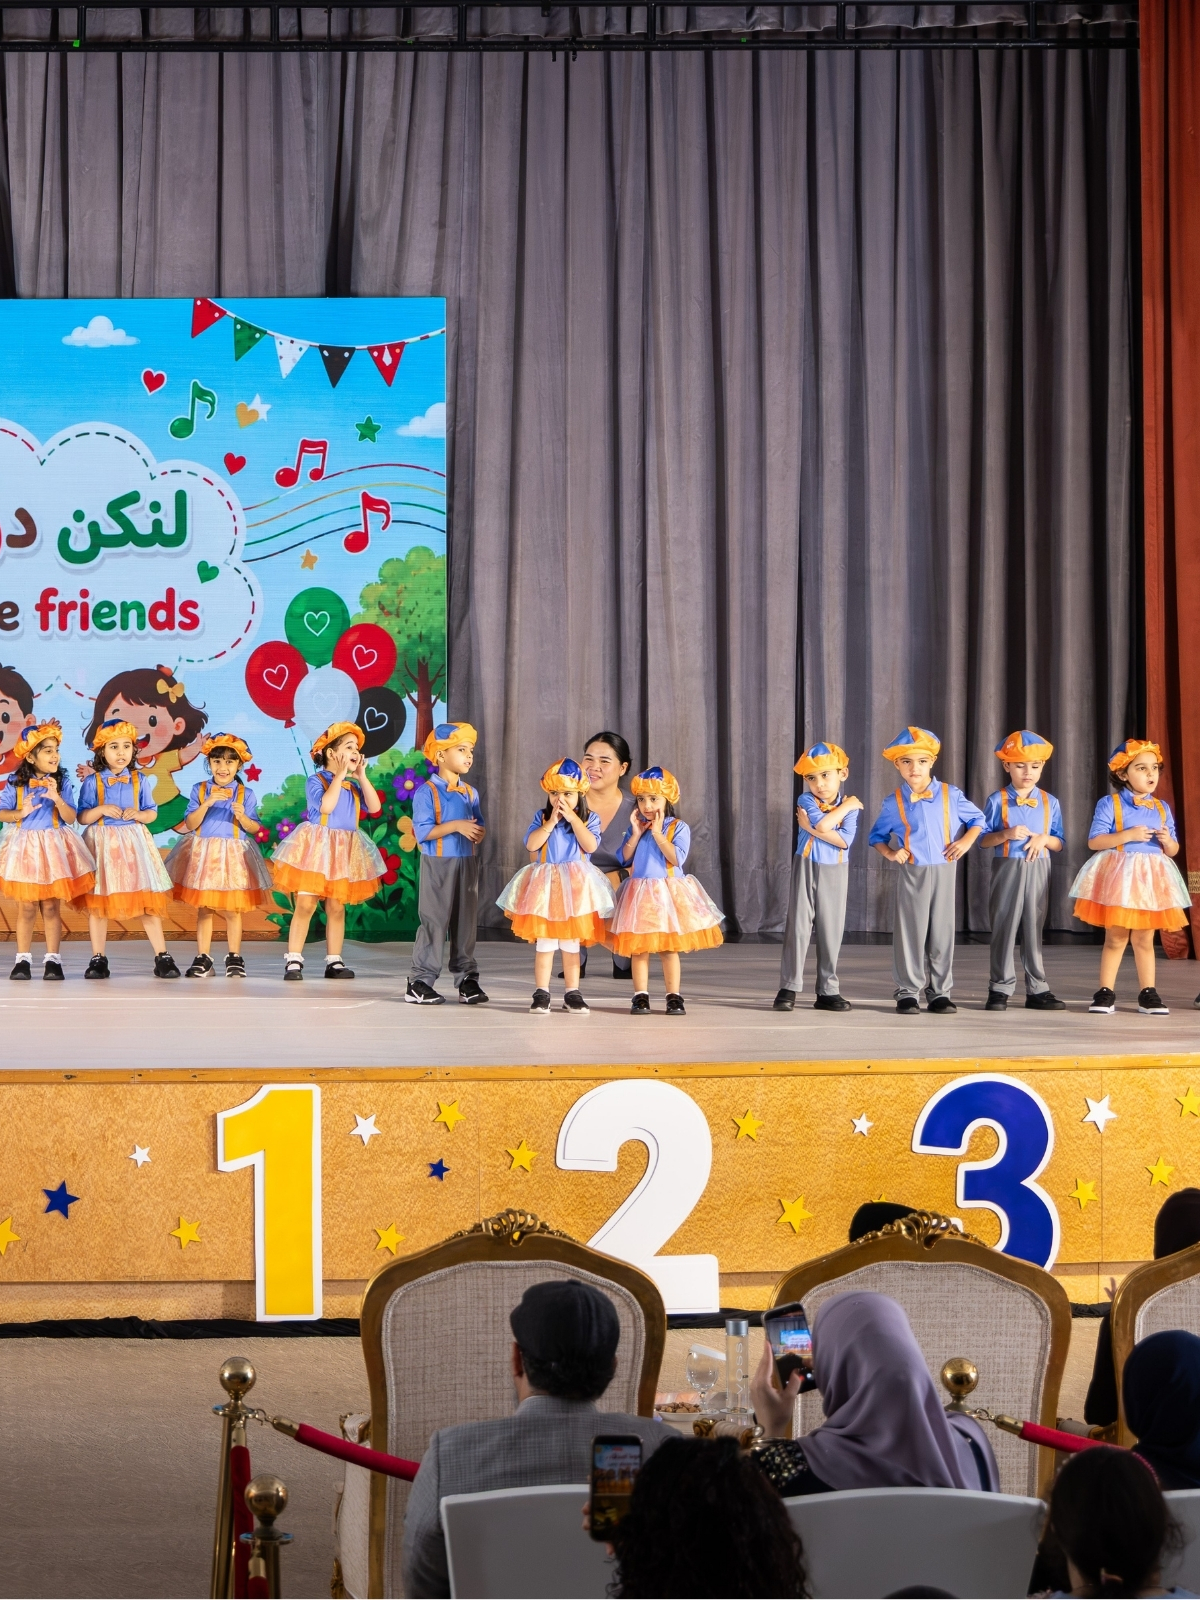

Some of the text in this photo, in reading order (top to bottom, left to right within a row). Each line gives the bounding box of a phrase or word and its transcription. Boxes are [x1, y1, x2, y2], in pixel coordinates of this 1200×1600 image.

[57, 489, 188, 565] لنكن
[35, 587, 200, 632] friends
[216, 1073, 1061, 1322] 1 2 3
[735, 1341, 744, 1395] VOSS
